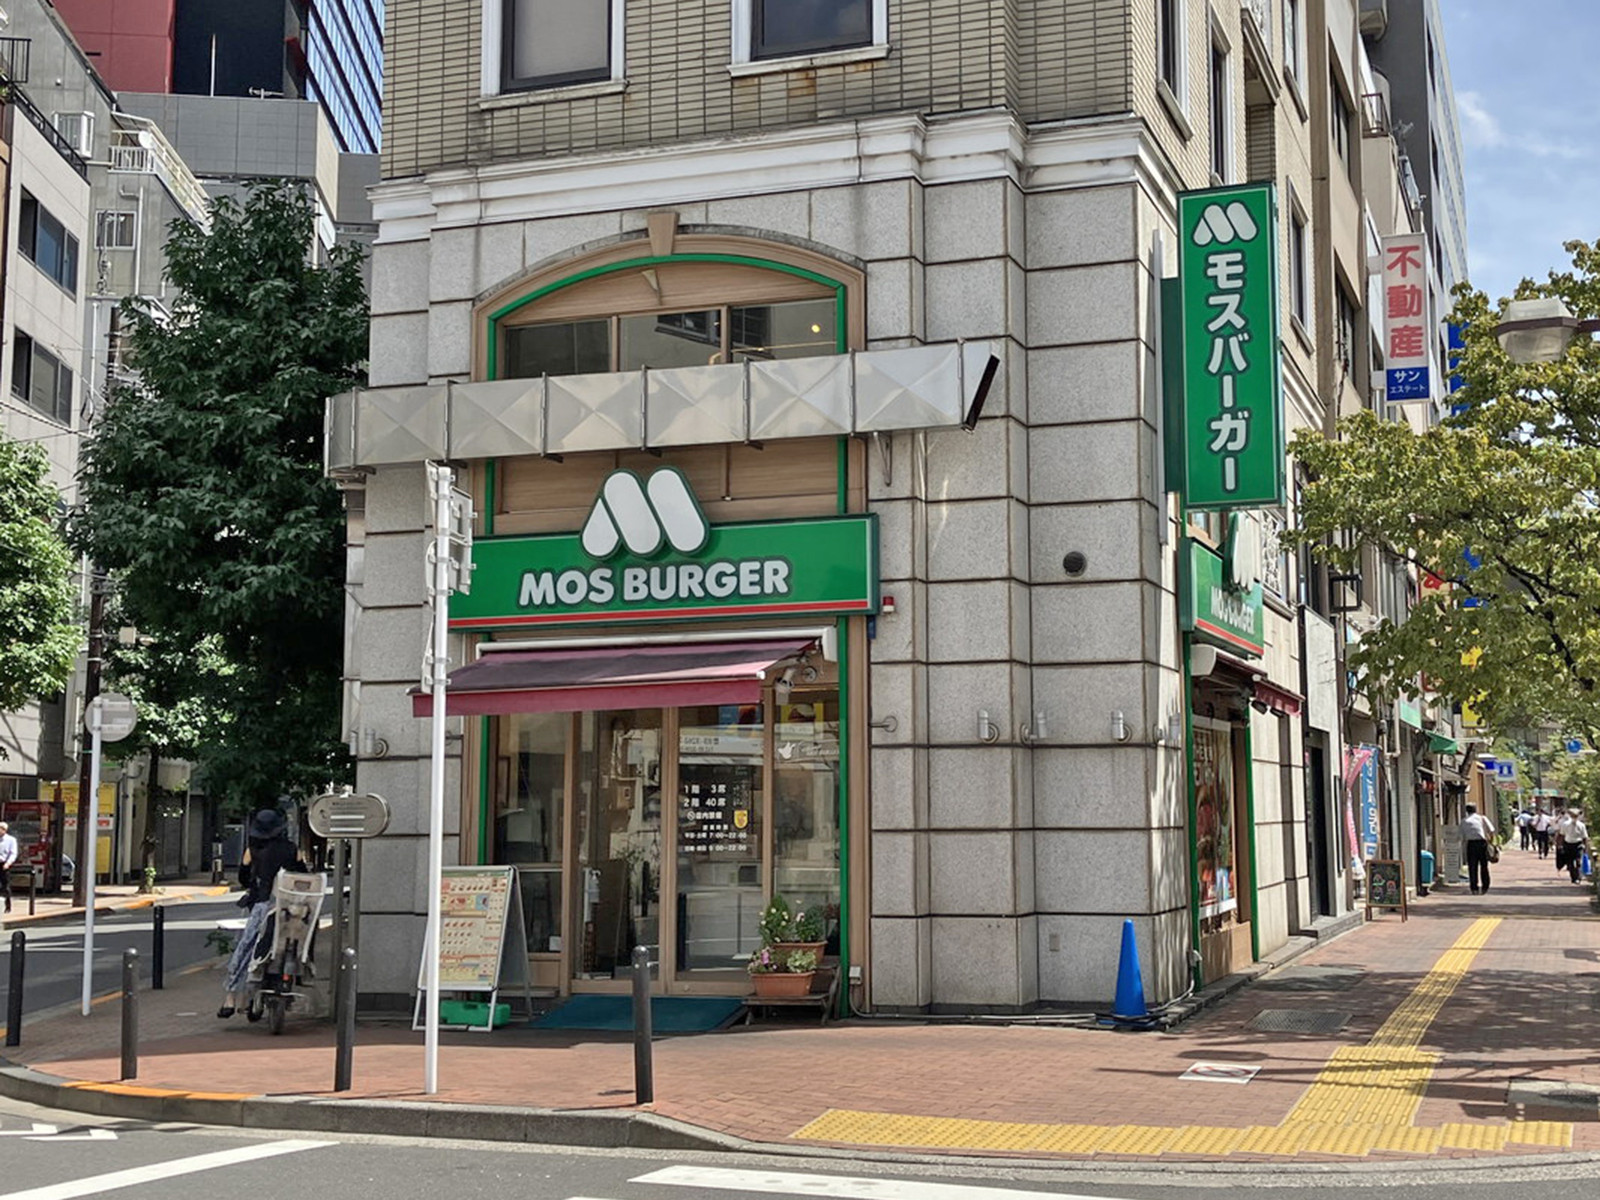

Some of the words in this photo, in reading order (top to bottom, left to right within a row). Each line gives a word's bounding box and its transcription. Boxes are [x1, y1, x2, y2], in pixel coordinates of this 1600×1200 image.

[1386, 245, 1424, 359] 不動産
[1206, 252, 1250, 491] モスバーガー
[1389, 385, 1426, 394] エステート
[1394, 370, 1420, 383] サン
[519, 567, 614, 606] MOS
[623, 560, 789, 600] BURGER
